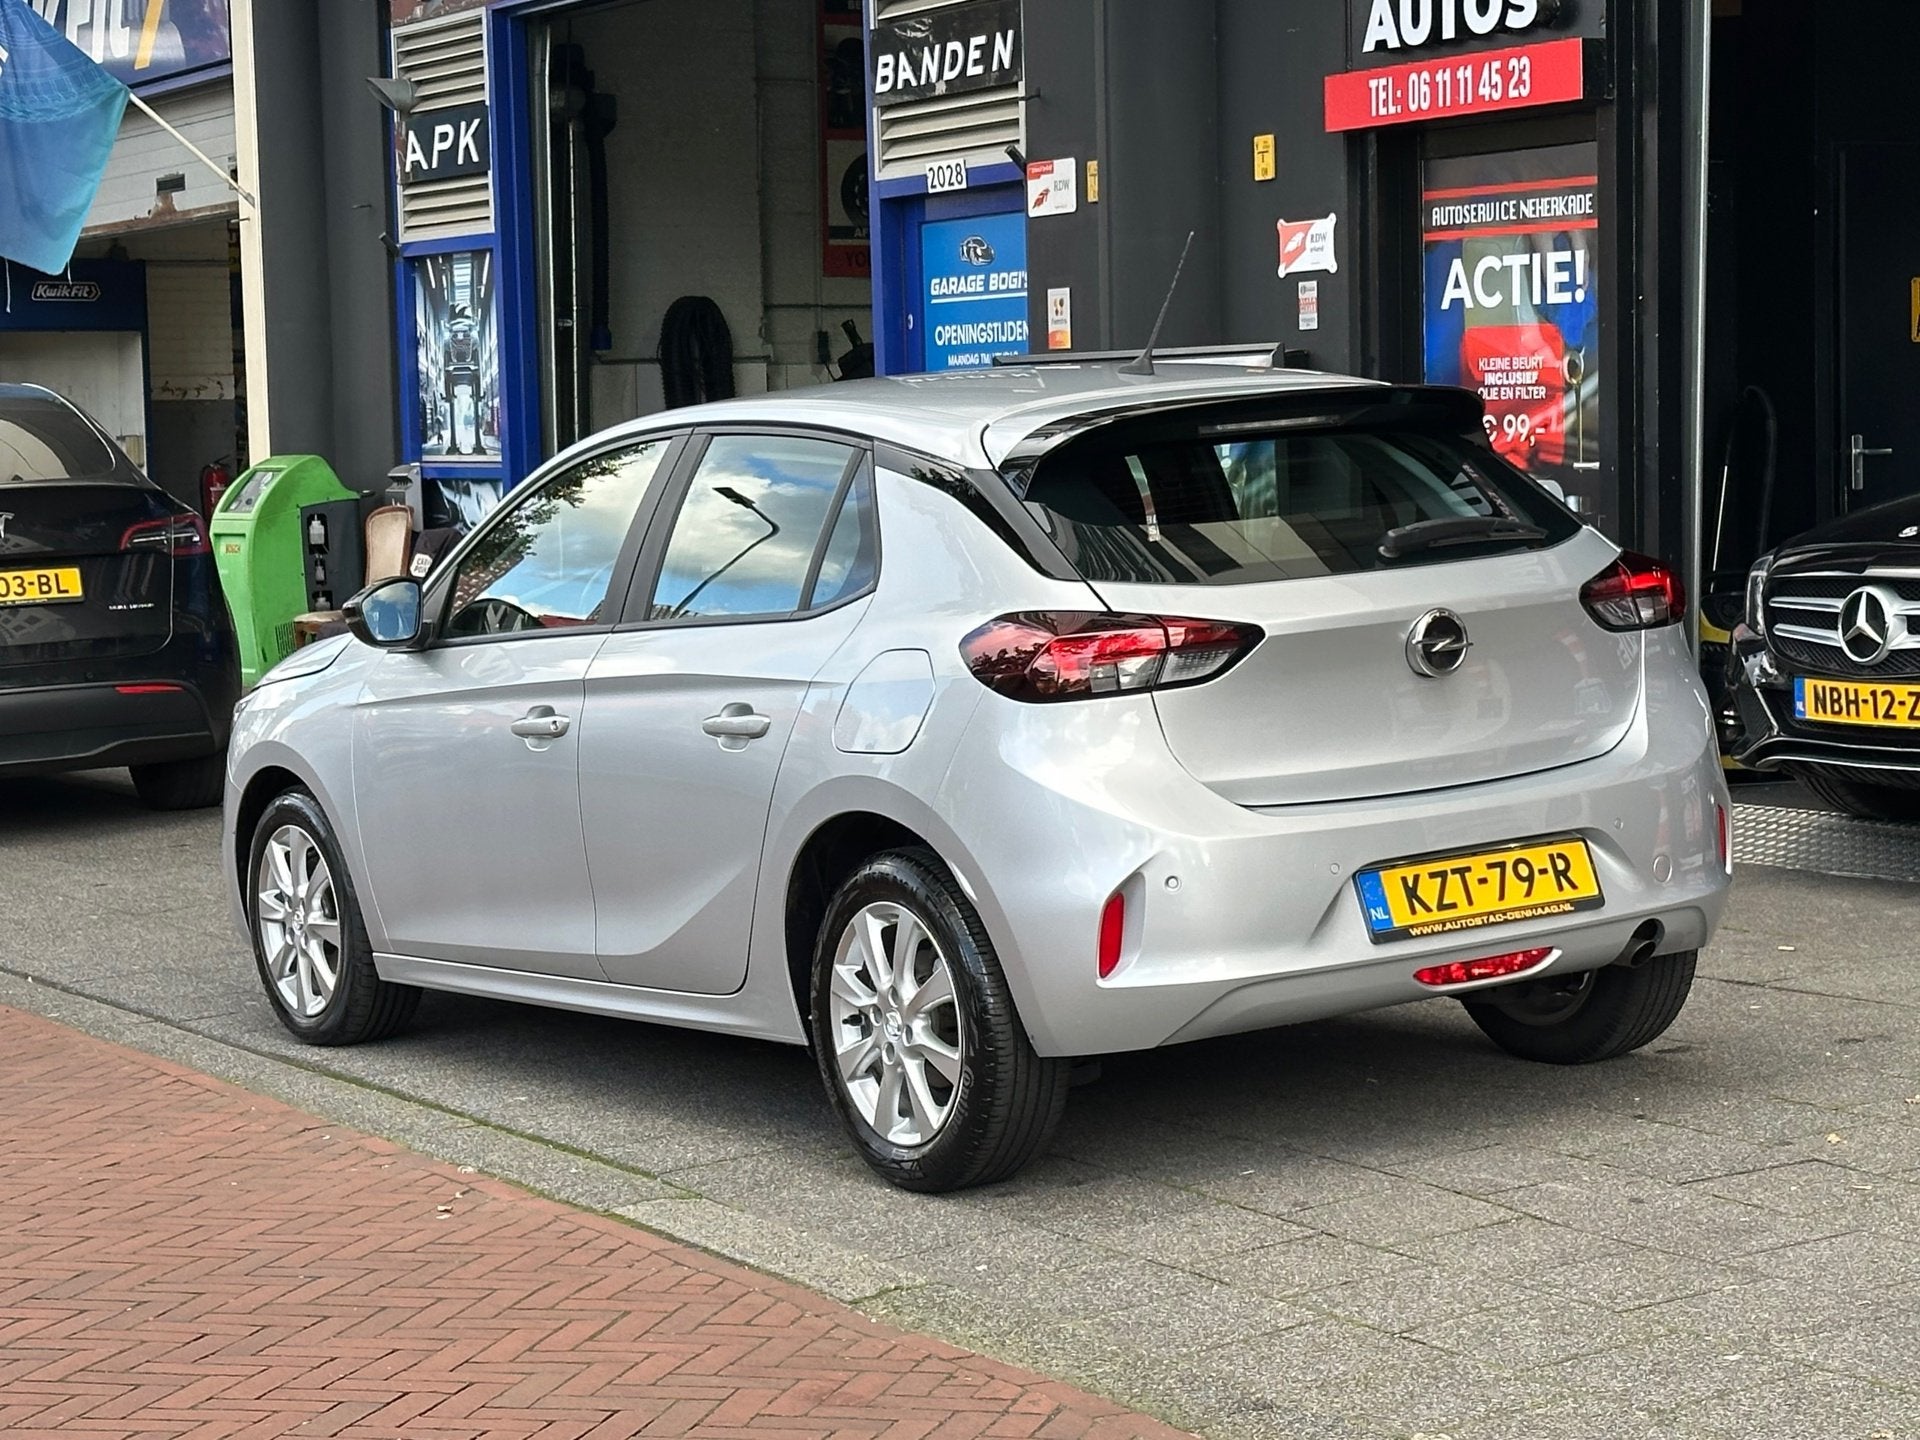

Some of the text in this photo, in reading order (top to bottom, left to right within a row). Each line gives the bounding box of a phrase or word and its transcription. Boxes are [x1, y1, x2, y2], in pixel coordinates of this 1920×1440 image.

[875, 29, 1015, 94] BANDEN
[1368, 55, 1531, 117] TEL: 06 11 11 45 23
[405, 118, 481, 173] APK
[928, 162, 964, 190] 2028
[1053, 179, 1071, 192] RDW
[1432, 193, 1594, 227] AUTOSERVICE NEHERKADE
[1310, 231, 1328, 244] RDW
[930, 274, 985, 296] GARAGE
[1440, 249, 1586, 310] ACTIE!
[1478, 355, 1544, 371] KLEINE BEURT
[1484, 371, 1539, 386] INCLUSIEF
[1478, 385, 1547, 400] OLIE EN FILTER
[1503, 413, 1546, 447] 99,-
[1813, 684, 1920, 720] NBH-12-Z
[1400, 852, 1579, 915] KZT-79-R
[1370, 908, 1389, 921] NL
